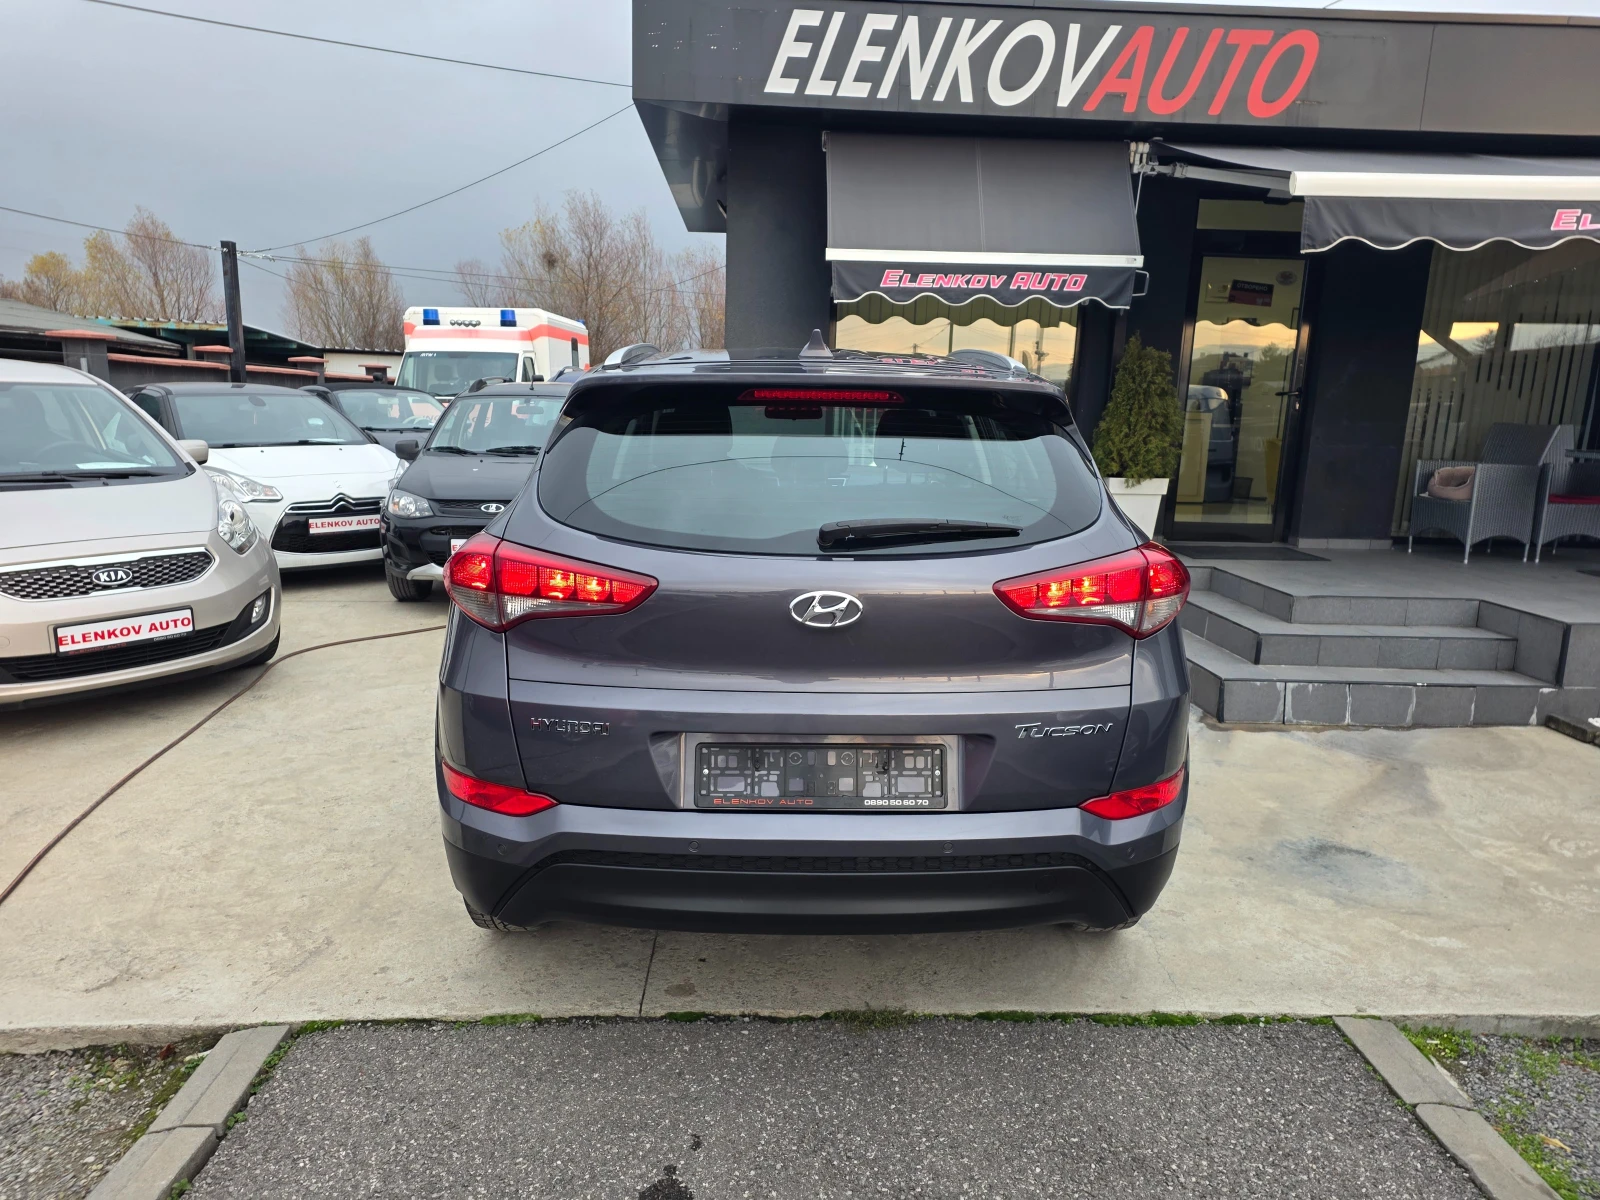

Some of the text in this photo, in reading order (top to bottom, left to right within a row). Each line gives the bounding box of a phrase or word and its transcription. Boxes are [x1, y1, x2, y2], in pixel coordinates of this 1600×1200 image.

[880, 269, 1088, 291] ELENKOV AUTO
[309, 518, 380, 529] ELENKOV AUTO
[99, 570, 127, 582] KIA
[58, 617, 191, 647] ELENKOV AUTO
[530, 717, 610, 736] HYUNDAI
[1015, 722, 1113, 739] TUCSON
[713, 798, 814, 806] ELENKOV AUTO
